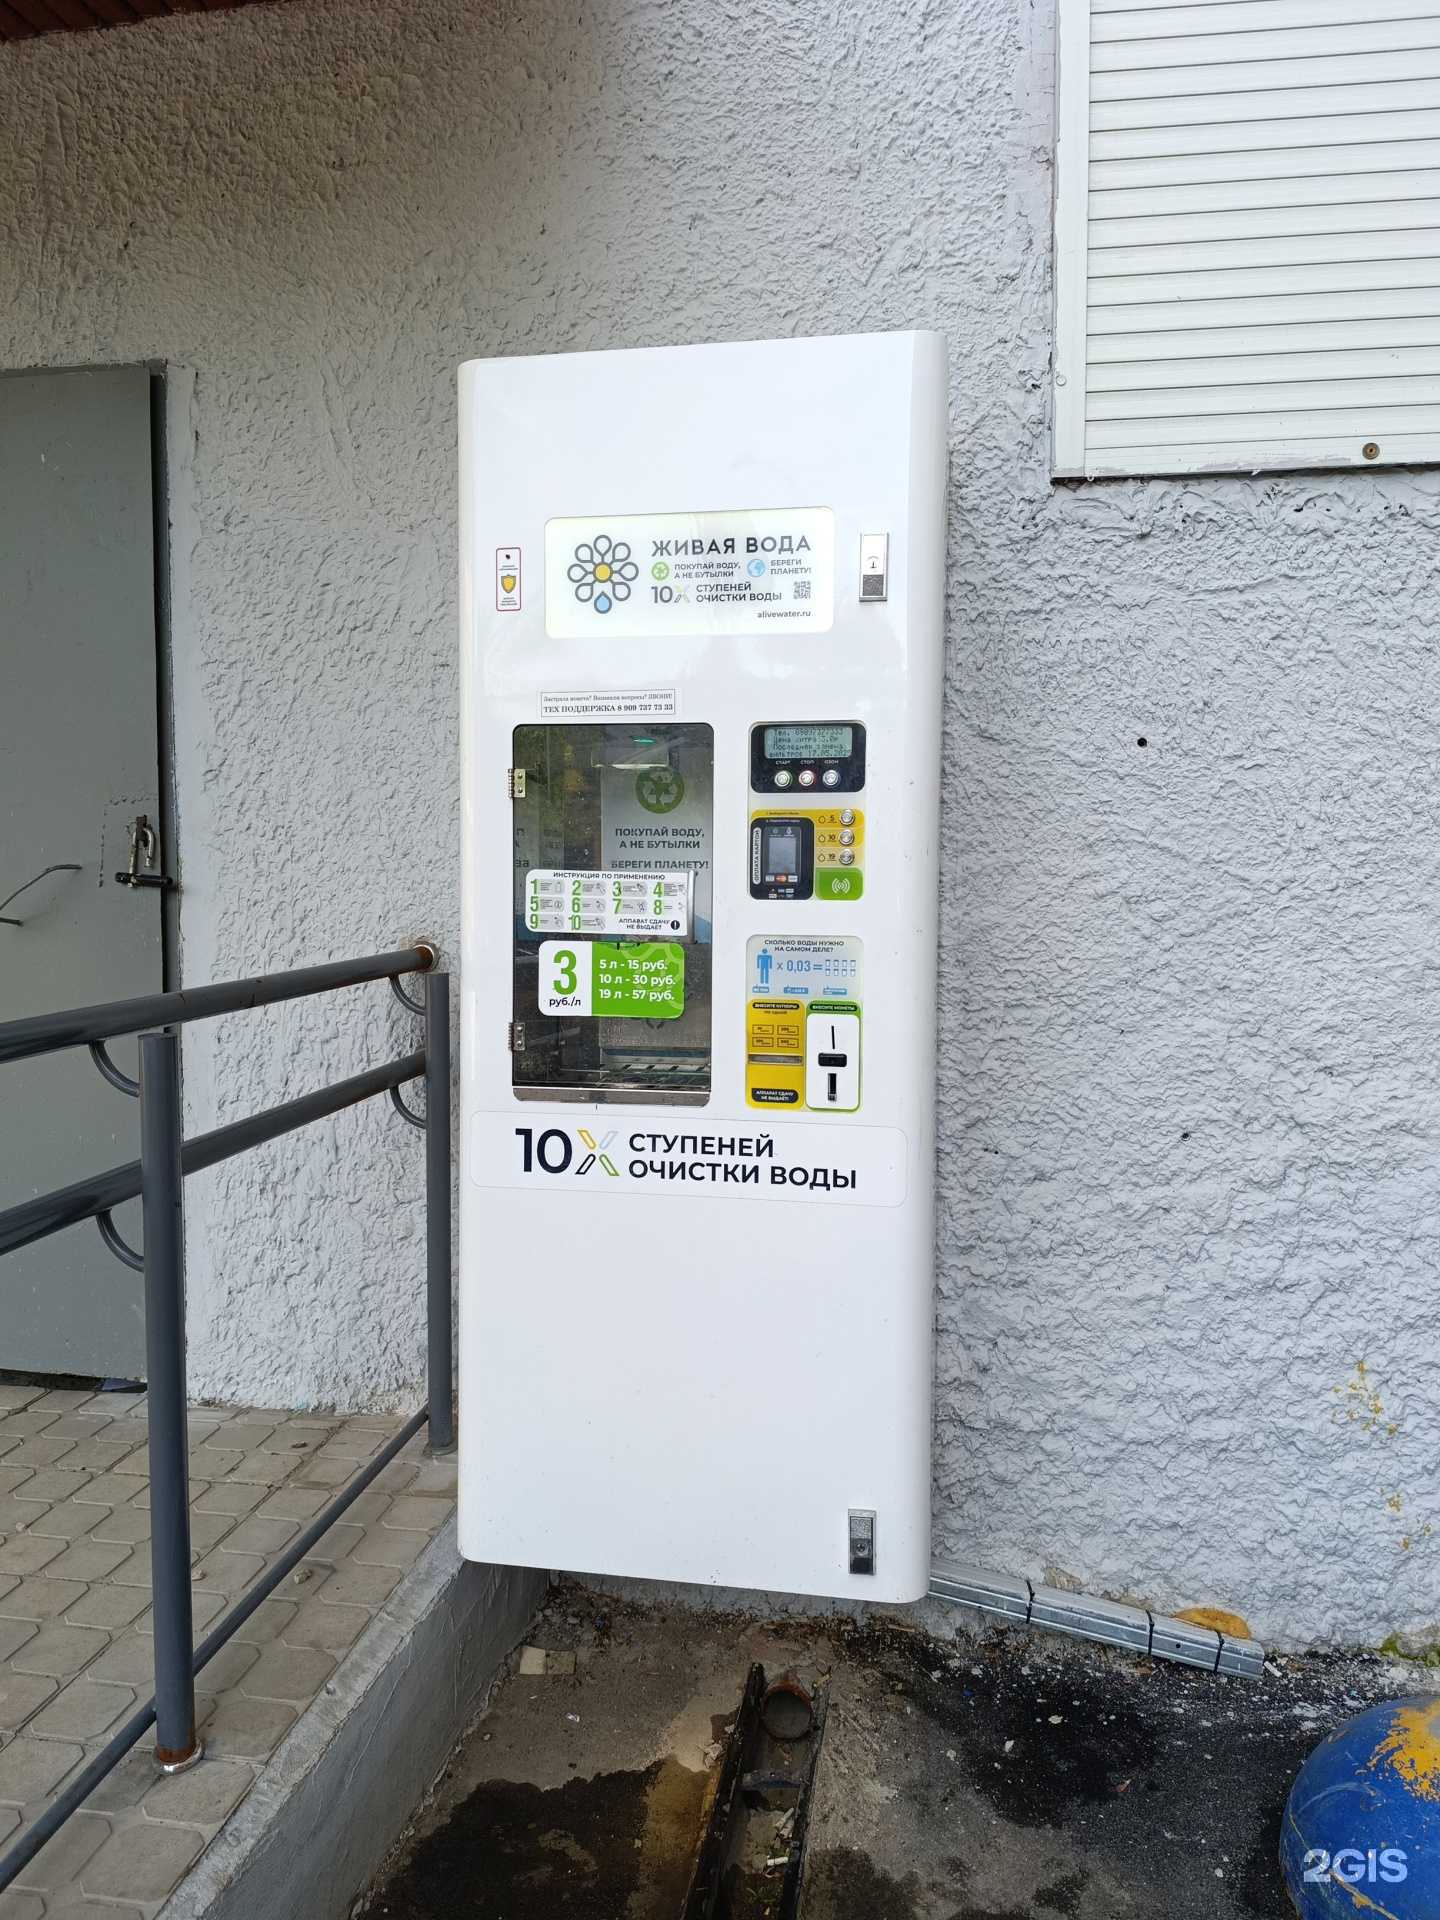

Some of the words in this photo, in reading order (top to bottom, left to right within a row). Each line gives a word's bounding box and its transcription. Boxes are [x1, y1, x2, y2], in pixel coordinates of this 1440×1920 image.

[651, 538, 736, 557] ЖИВАЯ
[746, 535, 812, 555] ВОДА
[674, 561, 714, 571] ПОКУПАЙ
[770, 558, 802, 567] БЕРЕГИ
[674, 572, 680, 580] А
[681, 572, 693, 580] НЕ
[695, 571, 734, 579] БУТЫЛКИ
[696, 581, 752, 593] СТУПЕНЕЙ
[696, 592, 747, 602] ОЧИСТКИ
[750, 592, 782, 602] ВОДЫ
[757, 609, 811, 619] alivewater.ru
[561, 705, 615, 713] ПОДДЕРЖКА
[615, 827, 668, 837] ПОКУПАЙ
[672, 827, 705, 838] ВОДУ,
[619, 840, 627, 849] А
[630, 840, 645, 849] НЕ
[647, 840, 700, 849] БУТЫЛКИ
[611, 860, 651, 869] БЕРЕГИ
[654, 860, 709, 869] ПЛАНЕТУ!
[530, 879, 538, 895] 1
[572, 880, 581, 896] 2
[612, 880, 622, 897] 3
[653, 882, 662, 898] 4
[530, 896, 539, 912] 5
[572, 897, 581, 913] 6
[612, 898, 621, 914] 7
[654, 900, 662, 916] 8
[530, 914, 538, 929] 9
[568, 915, 581, 930] 10
[599, 960, 607, 969] 5
[609, 961, 617, 969] л
[628, 960, 639, 970] 15
[642, 960, 668, 971] руб.
[786, 960, 811, 973] 0,03
[553, 950, 578, 996] 3
[599, 975, 612, 984] 10
[614, 976, 623, 984] л
[632, 975, 648, 985] 30
[650, 975, 676, 987] руб.
[599, 989, 611, 999] 19
[614, 991, 622, 999] л
[632, 990, 647, 999] 57
[649, 990, 675, 1002] руб.
[549, 997, 581, 1008] руб./л
[629, 1133, 774, 1158] СТУПЕНЕЙ
[629, 1159, 759, 1184] ОЧИСТКИ
[770, 1166, 856, 1191] ВОДЫ
